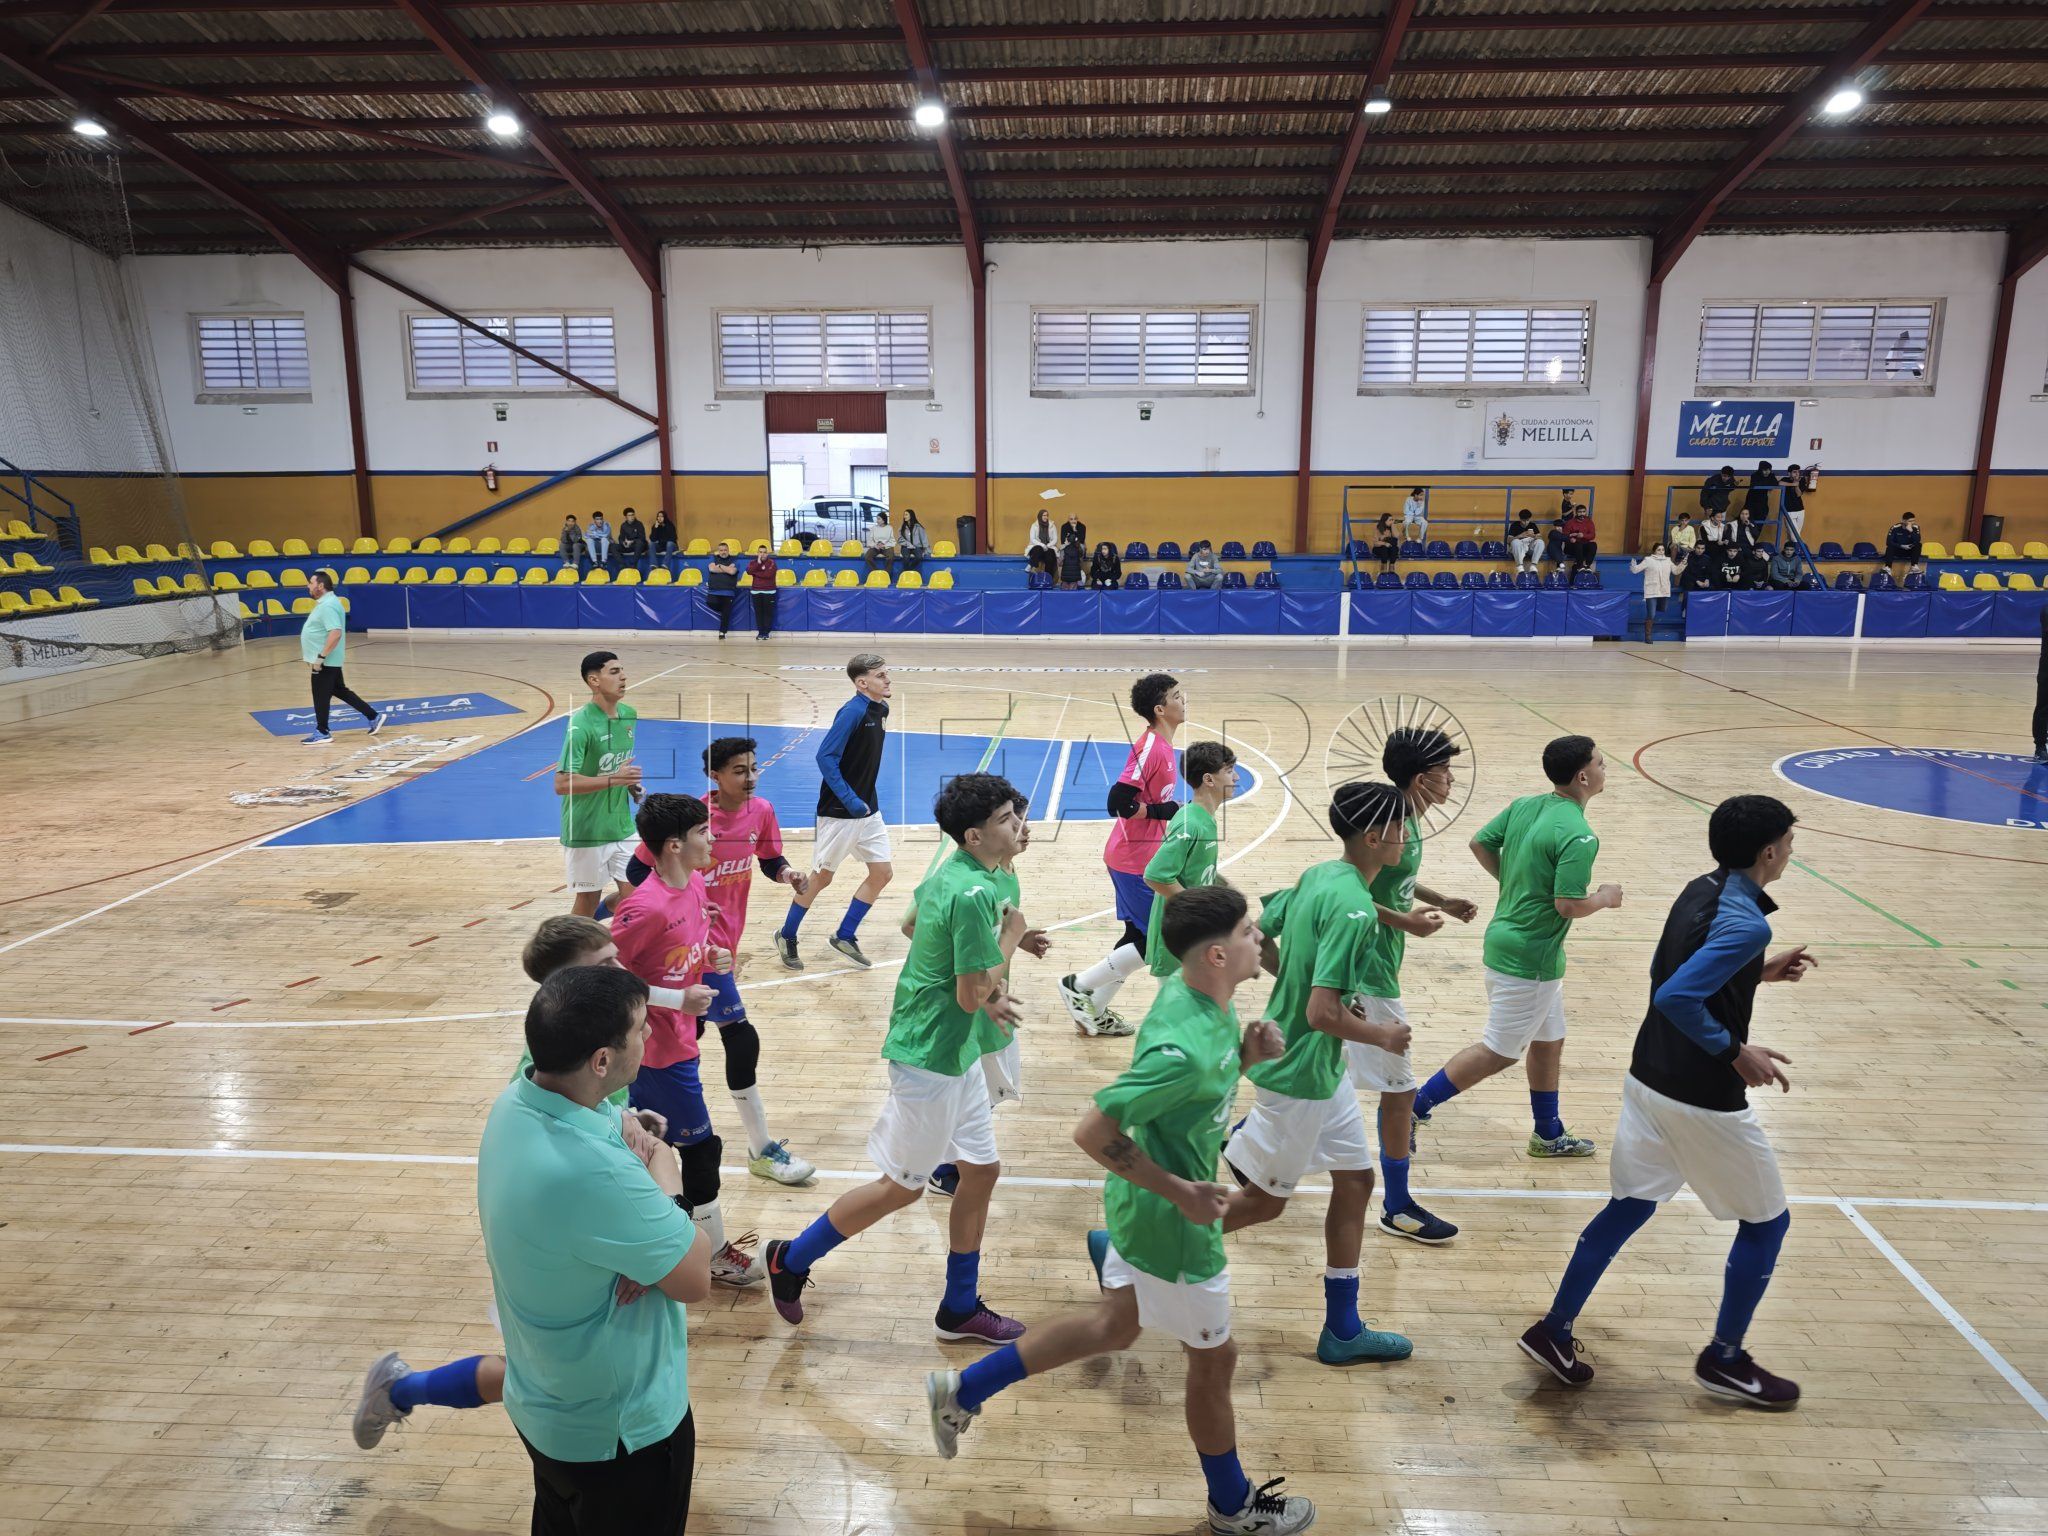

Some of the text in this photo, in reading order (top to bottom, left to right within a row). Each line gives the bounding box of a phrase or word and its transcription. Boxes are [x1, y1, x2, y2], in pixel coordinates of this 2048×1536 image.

[1689, 412, 1783, 437] MELILLA
[1521, 427, 1593, 442] MELILLA
[1689, 437, 1777, 447] CIUDAD DEL DEPORTE
[1794, 749, 1880, 769] CIUDAD
